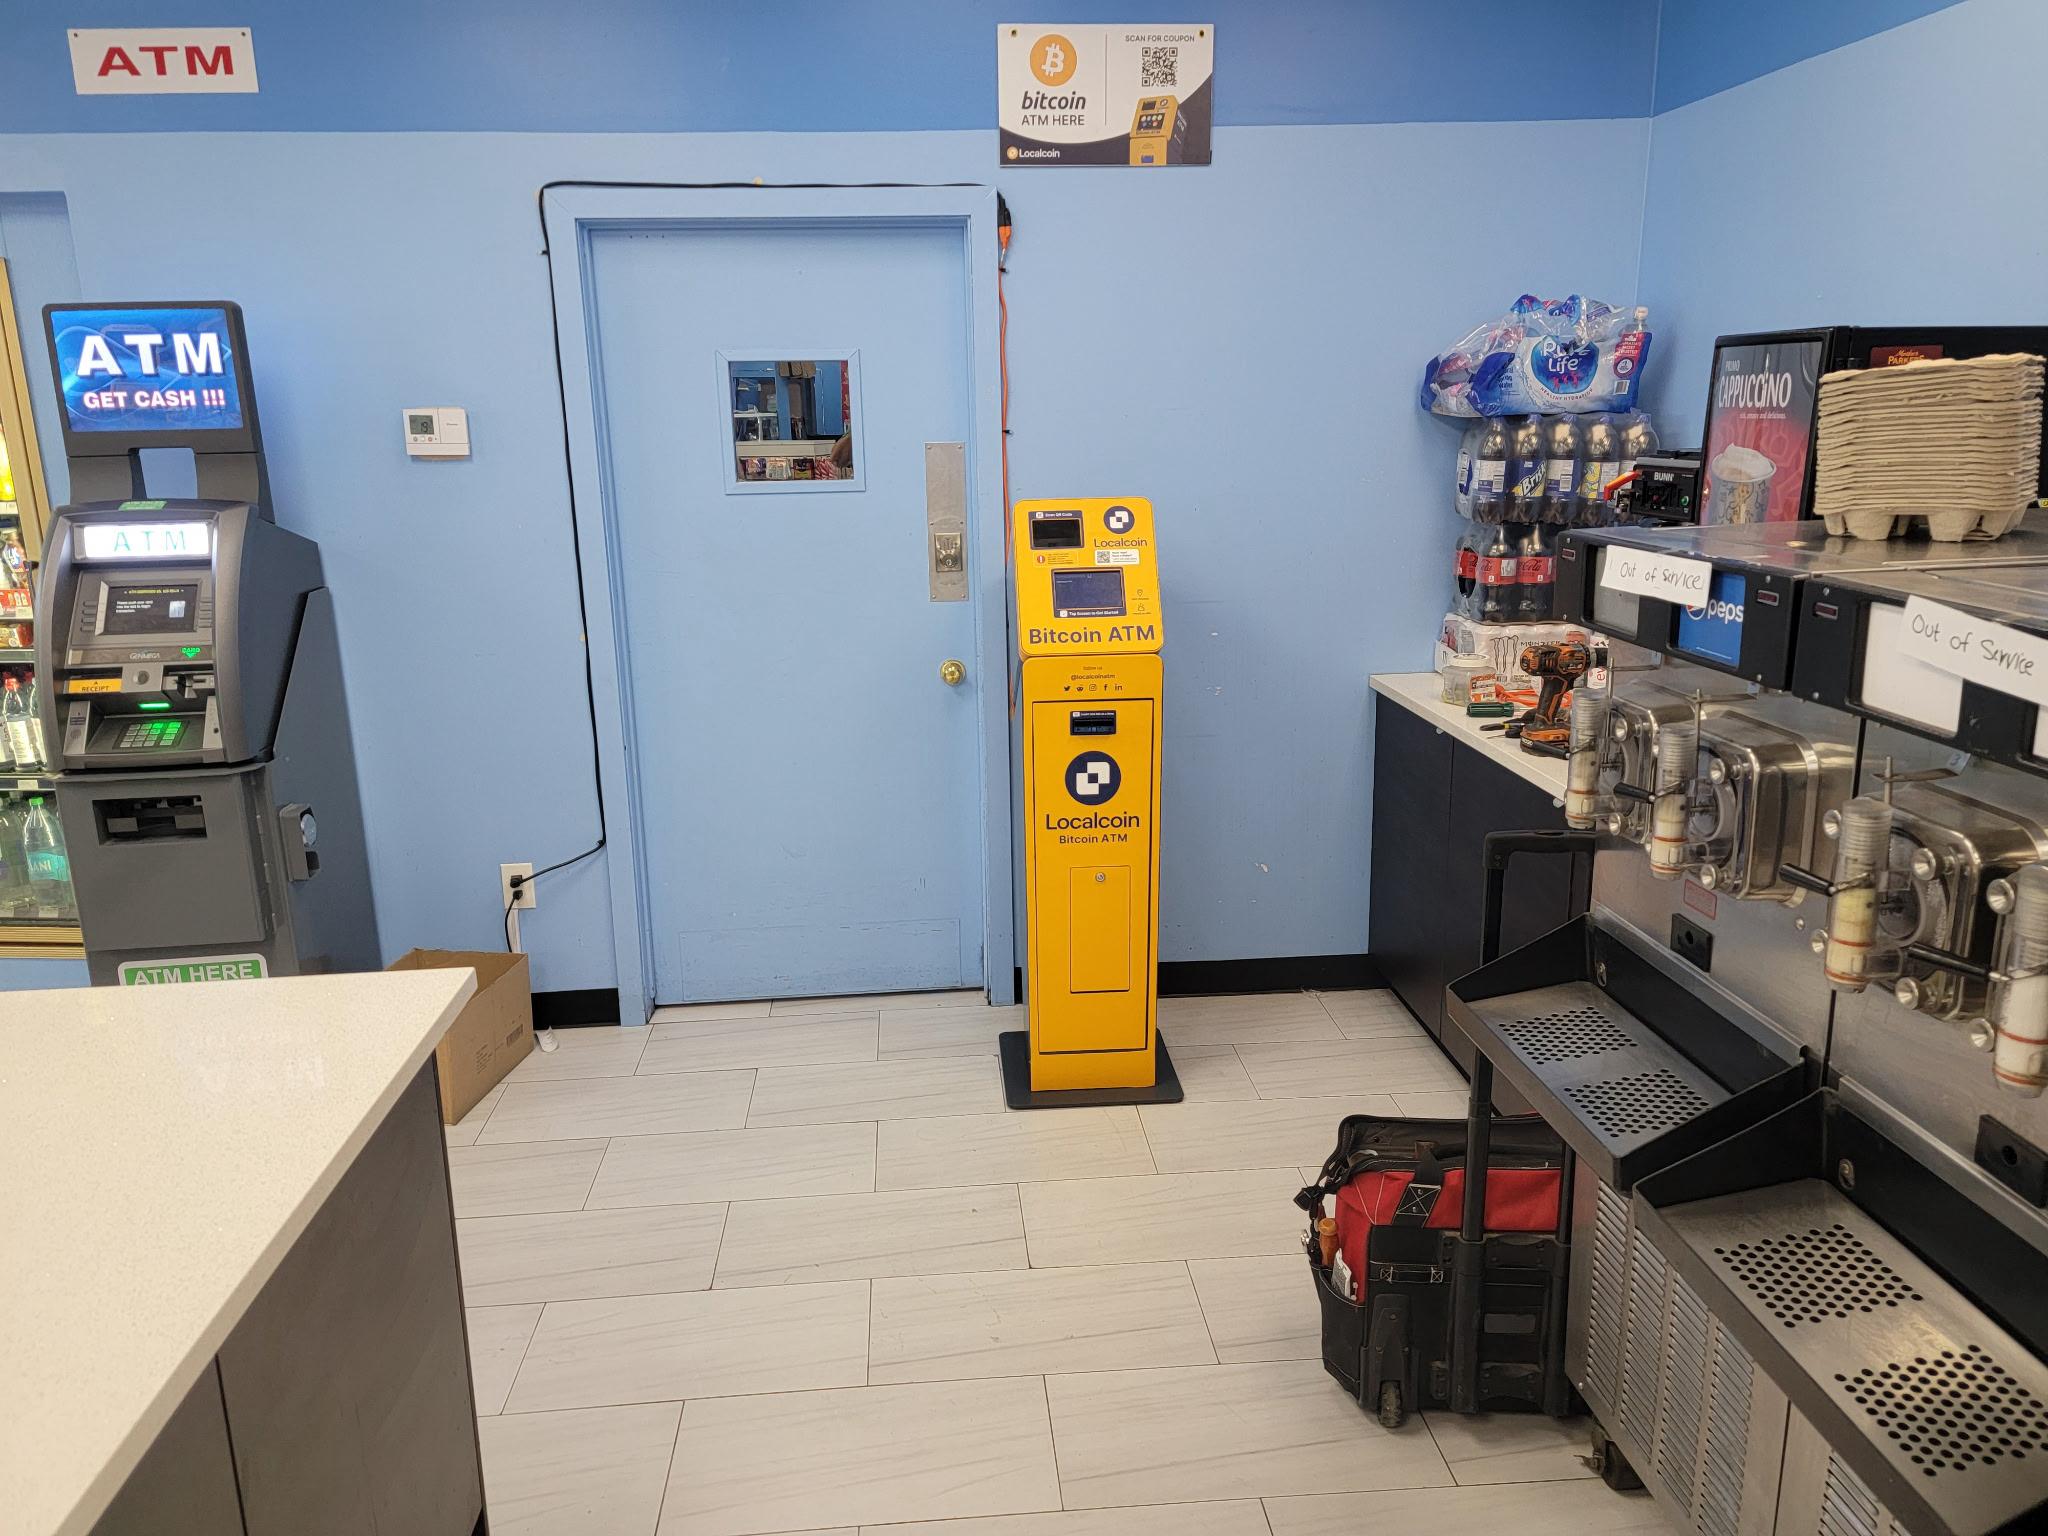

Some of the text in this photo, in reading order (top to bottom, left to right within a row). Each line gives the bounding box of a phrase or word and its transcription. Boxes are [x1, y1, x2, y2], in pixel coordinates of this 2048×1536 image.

[1125, 34, 1195, 42] SCAN FOR COUPON
[98, 45, 234, 76] ATM
[1021, 90, 1086, 110] bitcoin
[1021, 114, 1085, 126] ATM HERE
[1019, 148, 1060, 158] Localcoin
[77, 332, 224, 376] ATM
[1548, 356, 1579, 374] Life
[83, 388, 225, 409] GET CASH !!!
[1718, 371, 1792, 409] CAPPUCCINO
[1653, 471, 1674, 482] BUNN
[114, 530, 187, 553] ATM
[1094, 537, 1148, 548] Localcoin
[1620, 561, 1637, 578] Out
[1644, 567, 1658, 583] of
[1029, 624, 1155, 644] Bitcoin ATM
[1912, 614, 2035, 676] Out of Service
[1071, 673, 1116, 681] @localcoinatm
[81, 685, 110, 693] RECEIPT
[1046, 811, 1140, 830] Localcoin
[1059, 833, 1128, 844] Bitcoin ATM
[134, 962, 254, 985] ATM HERE
